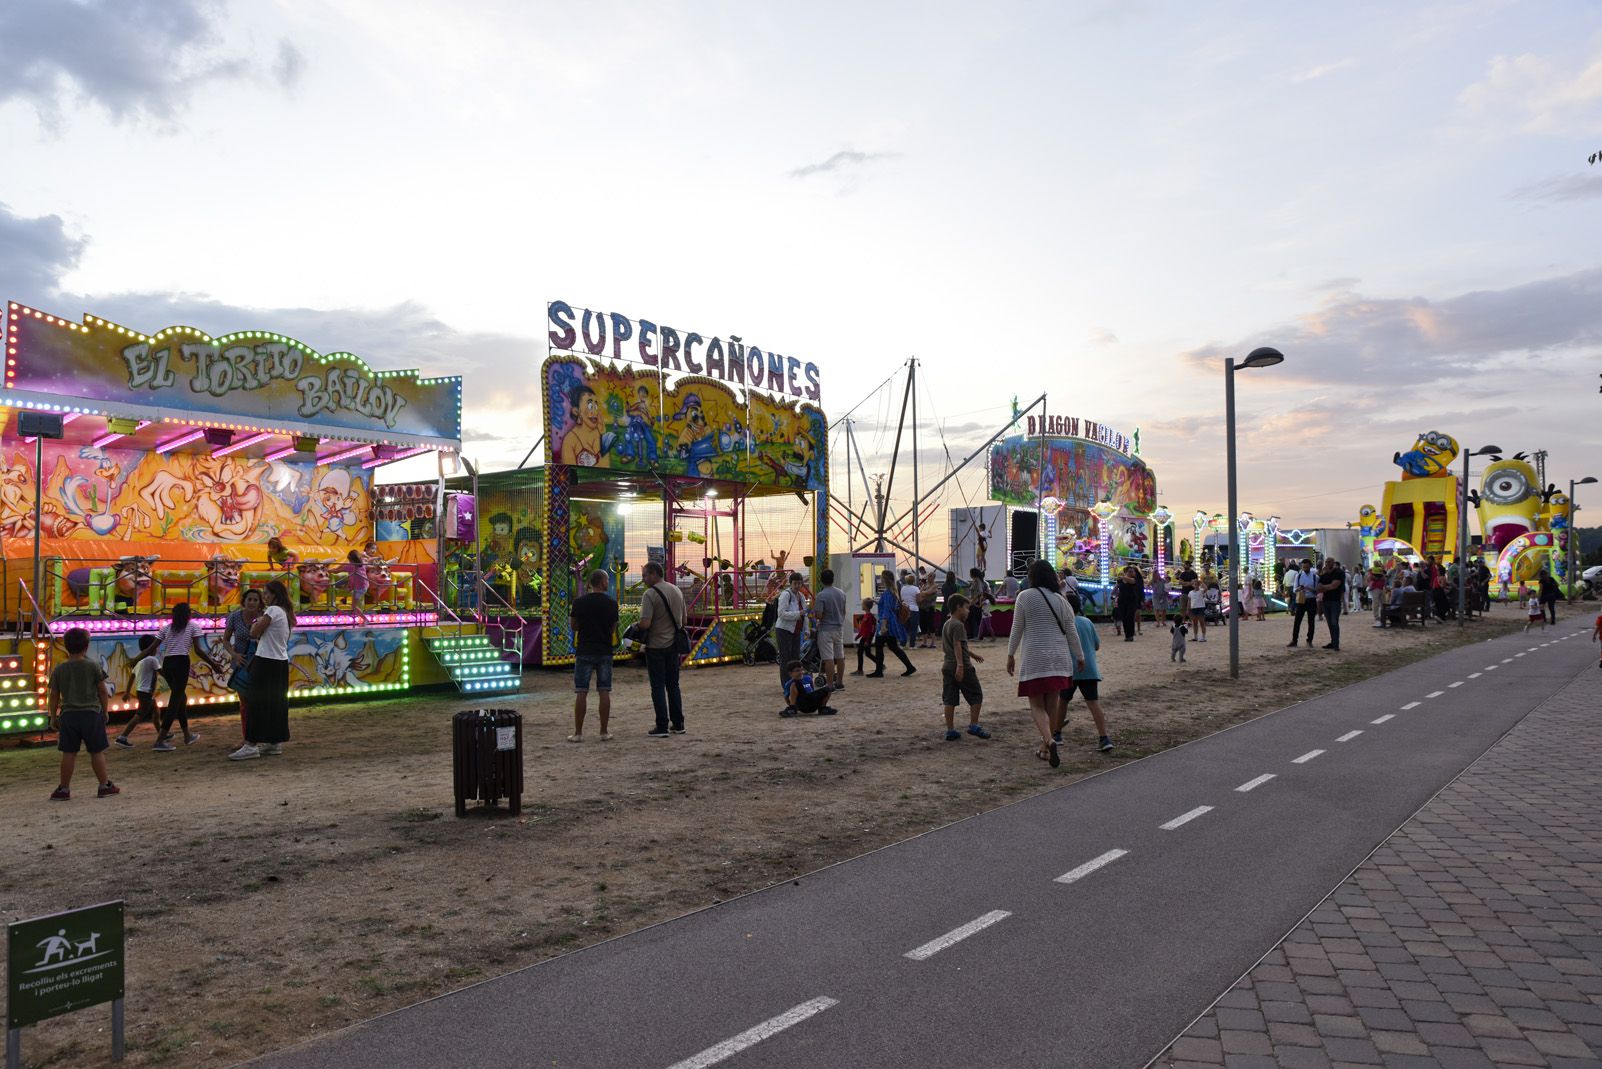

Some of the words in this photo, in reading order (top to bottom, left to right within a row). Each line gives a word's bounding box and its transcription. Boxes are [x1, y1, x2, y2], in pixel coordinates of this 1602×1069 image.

[122, 343, 176, 391] EL
[549, 300, 820, 400] SUPERCAÑONES
[19, 976, 55, 991] Recolliu
[56, 972, 68, 981] els
[70, 961, 117, 977] excrements
[40, 979, 81, 997] porteu-lo
[82, 972, 104, 984] lligat
